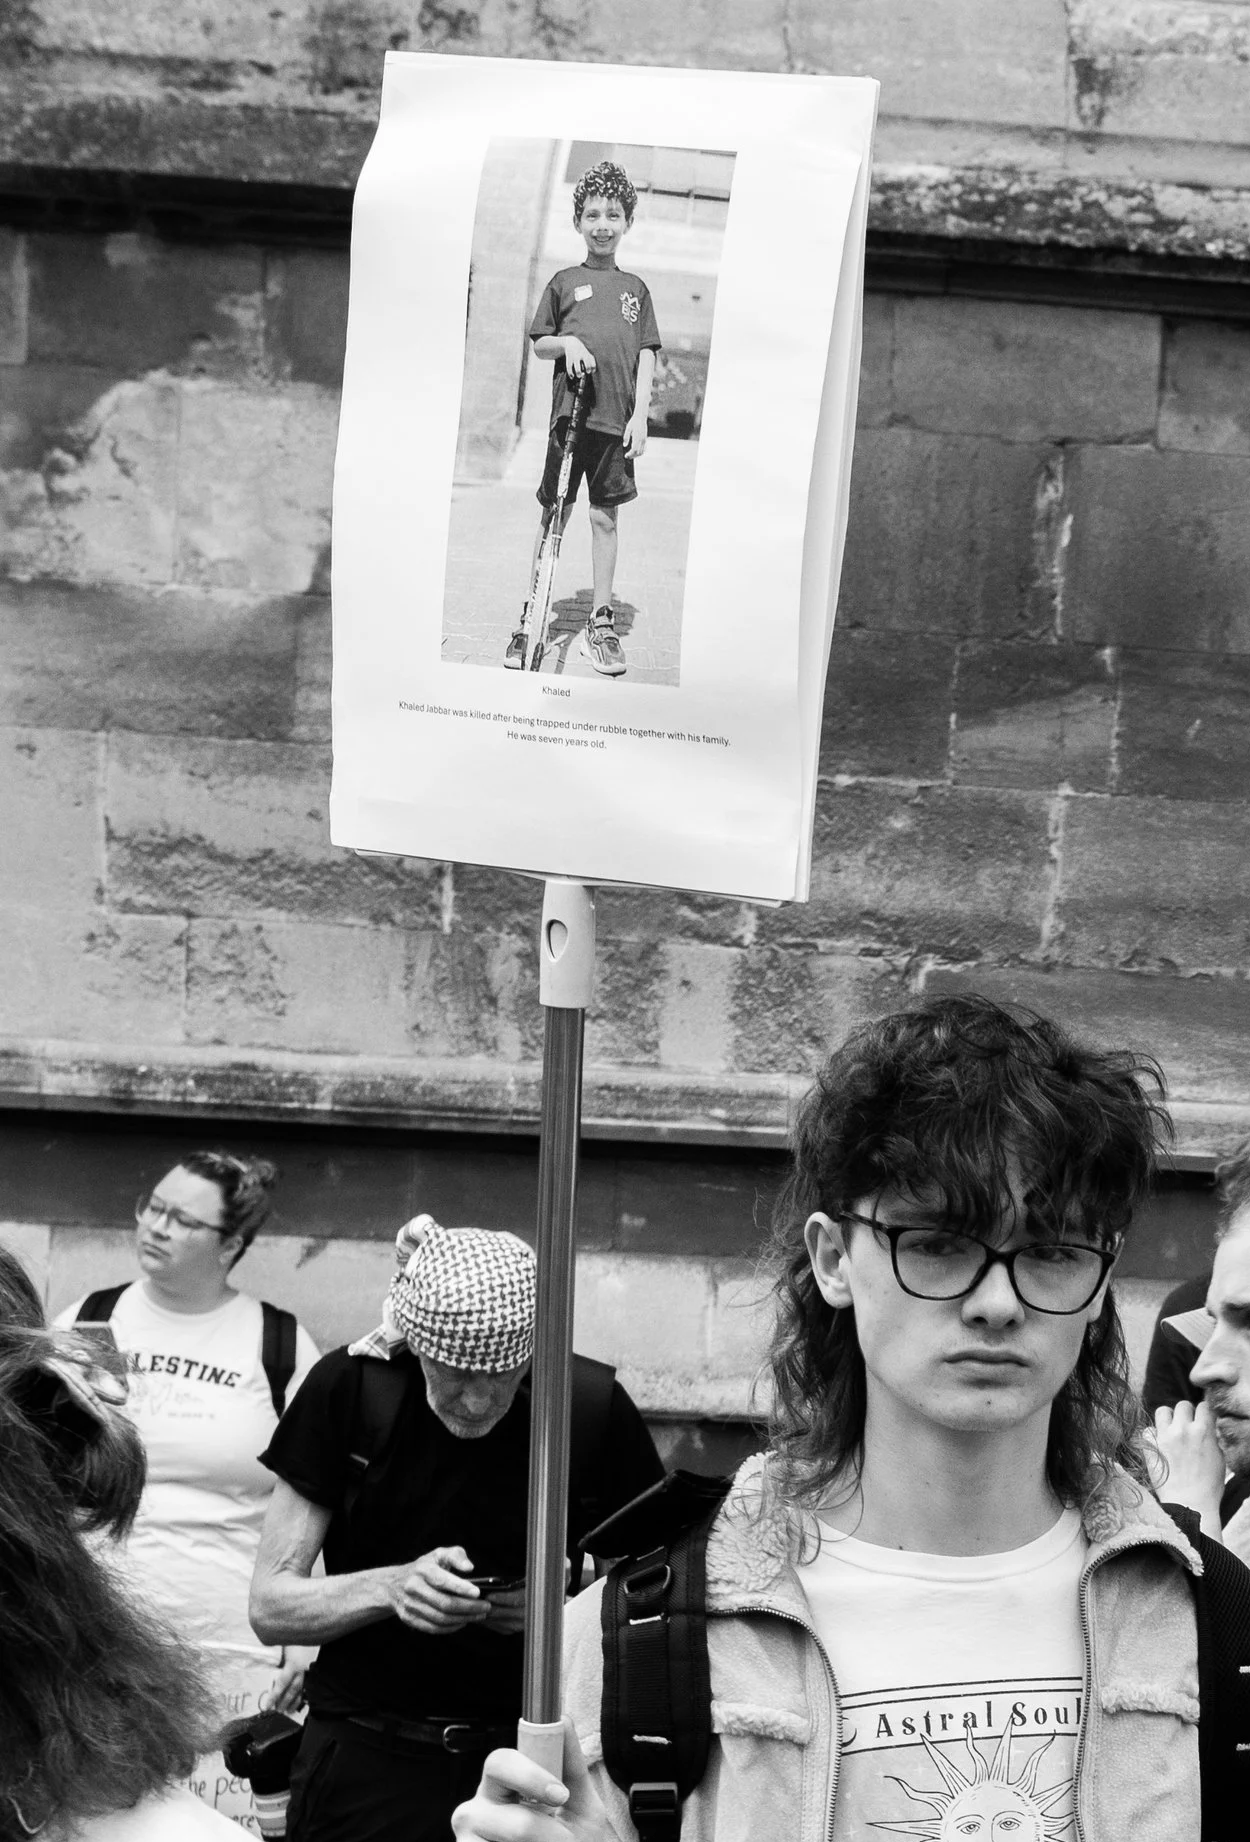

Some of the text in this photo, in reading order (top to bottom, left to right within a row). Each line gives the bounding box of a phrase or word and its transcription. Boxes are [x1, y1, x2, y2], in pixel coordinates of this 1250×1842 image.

[542, 686, 571, 698] Khaled
[398, 701, 731, 747] Khaled Jabbar was killed after being trapped under rubble together with his family.
[507, 730, 607, 750] He was seven years old.
[132, 1353, 242, 1388] LESTINE
[876, 1700, 994, 1738] Astral
